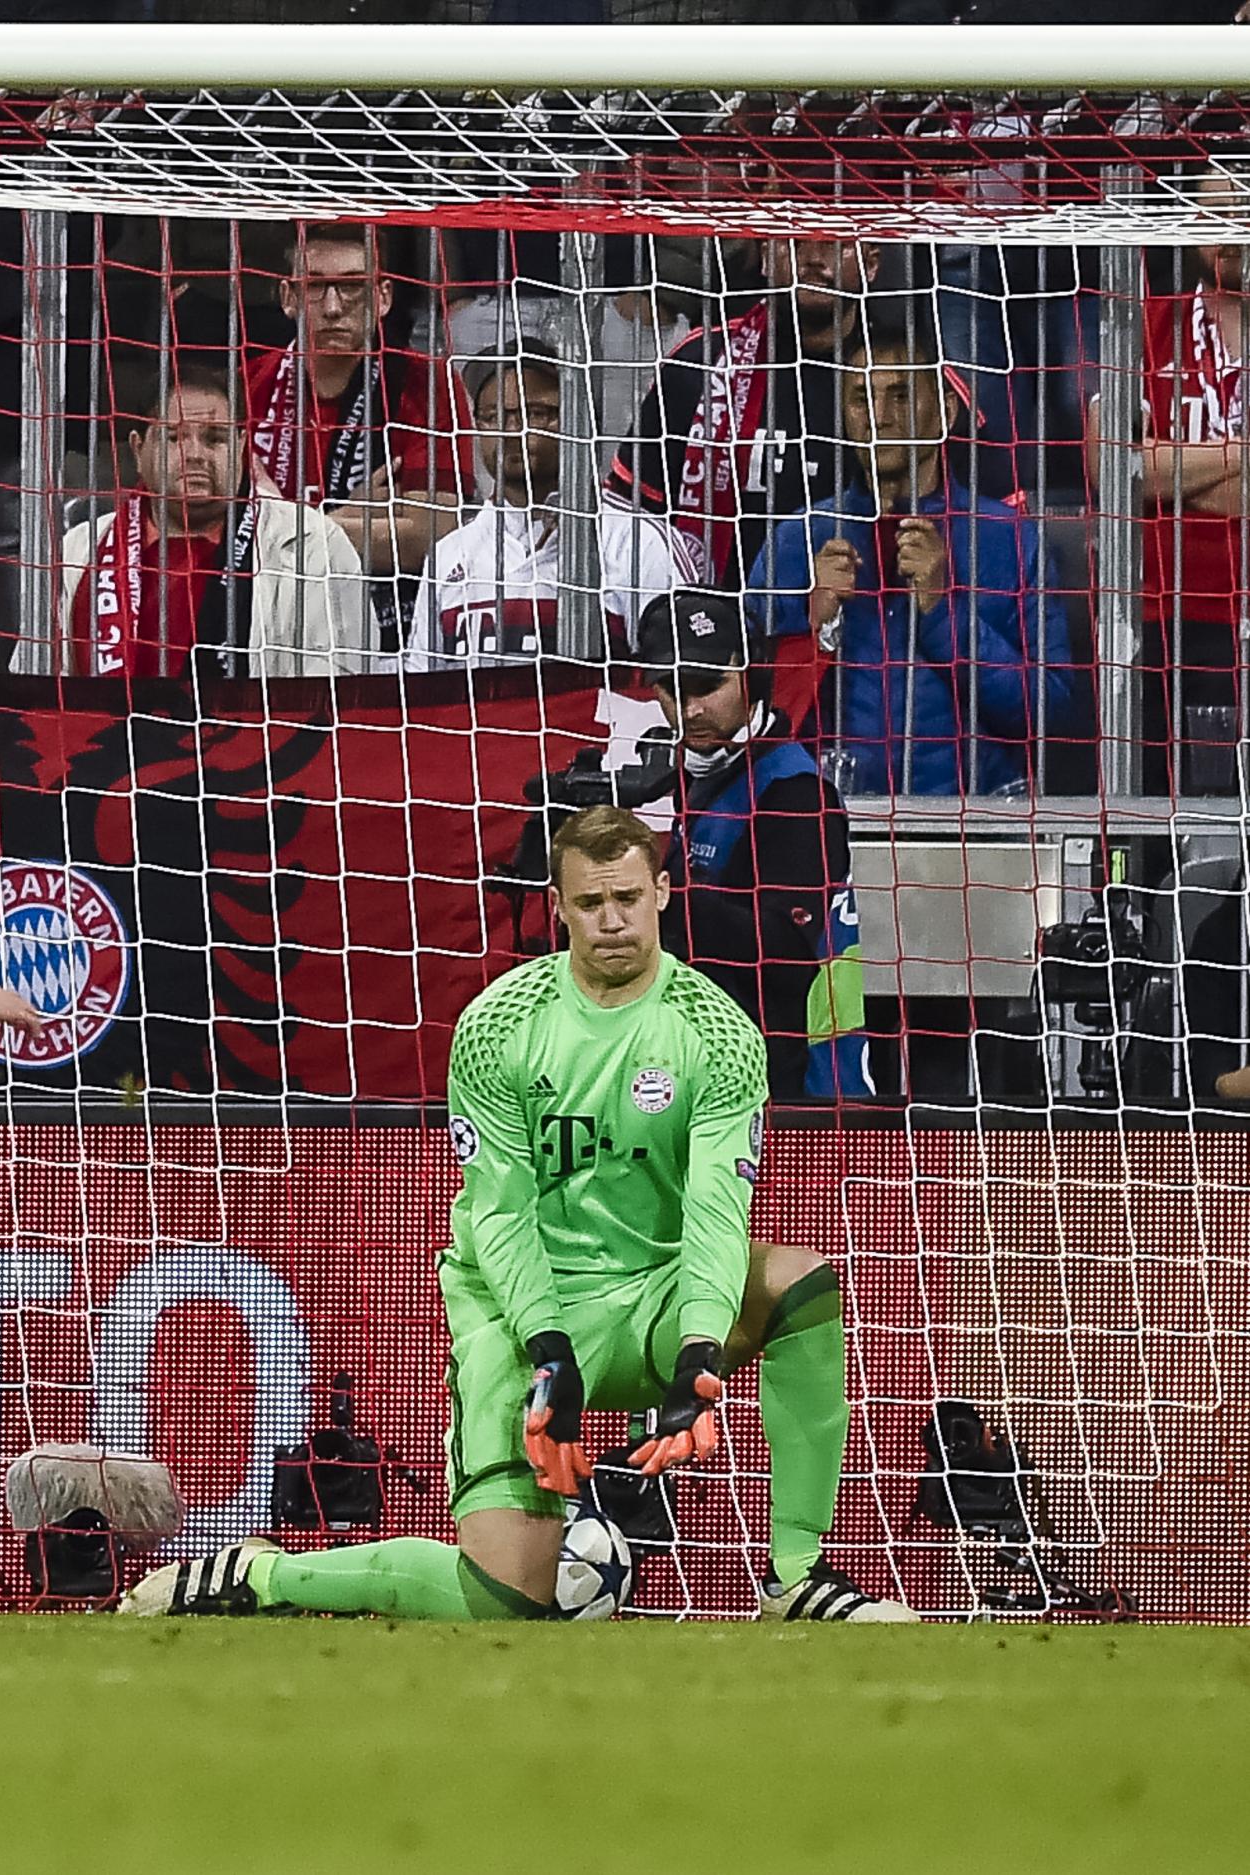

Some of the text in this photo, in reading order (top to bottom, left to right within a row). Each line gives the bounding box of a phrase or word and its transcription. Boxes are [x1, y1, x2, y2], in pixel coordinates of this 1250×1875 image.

[678, 459, 706, 507] FC
[714, 458, 730, 492] UEFA
[97, 624, 124, 675] FC
